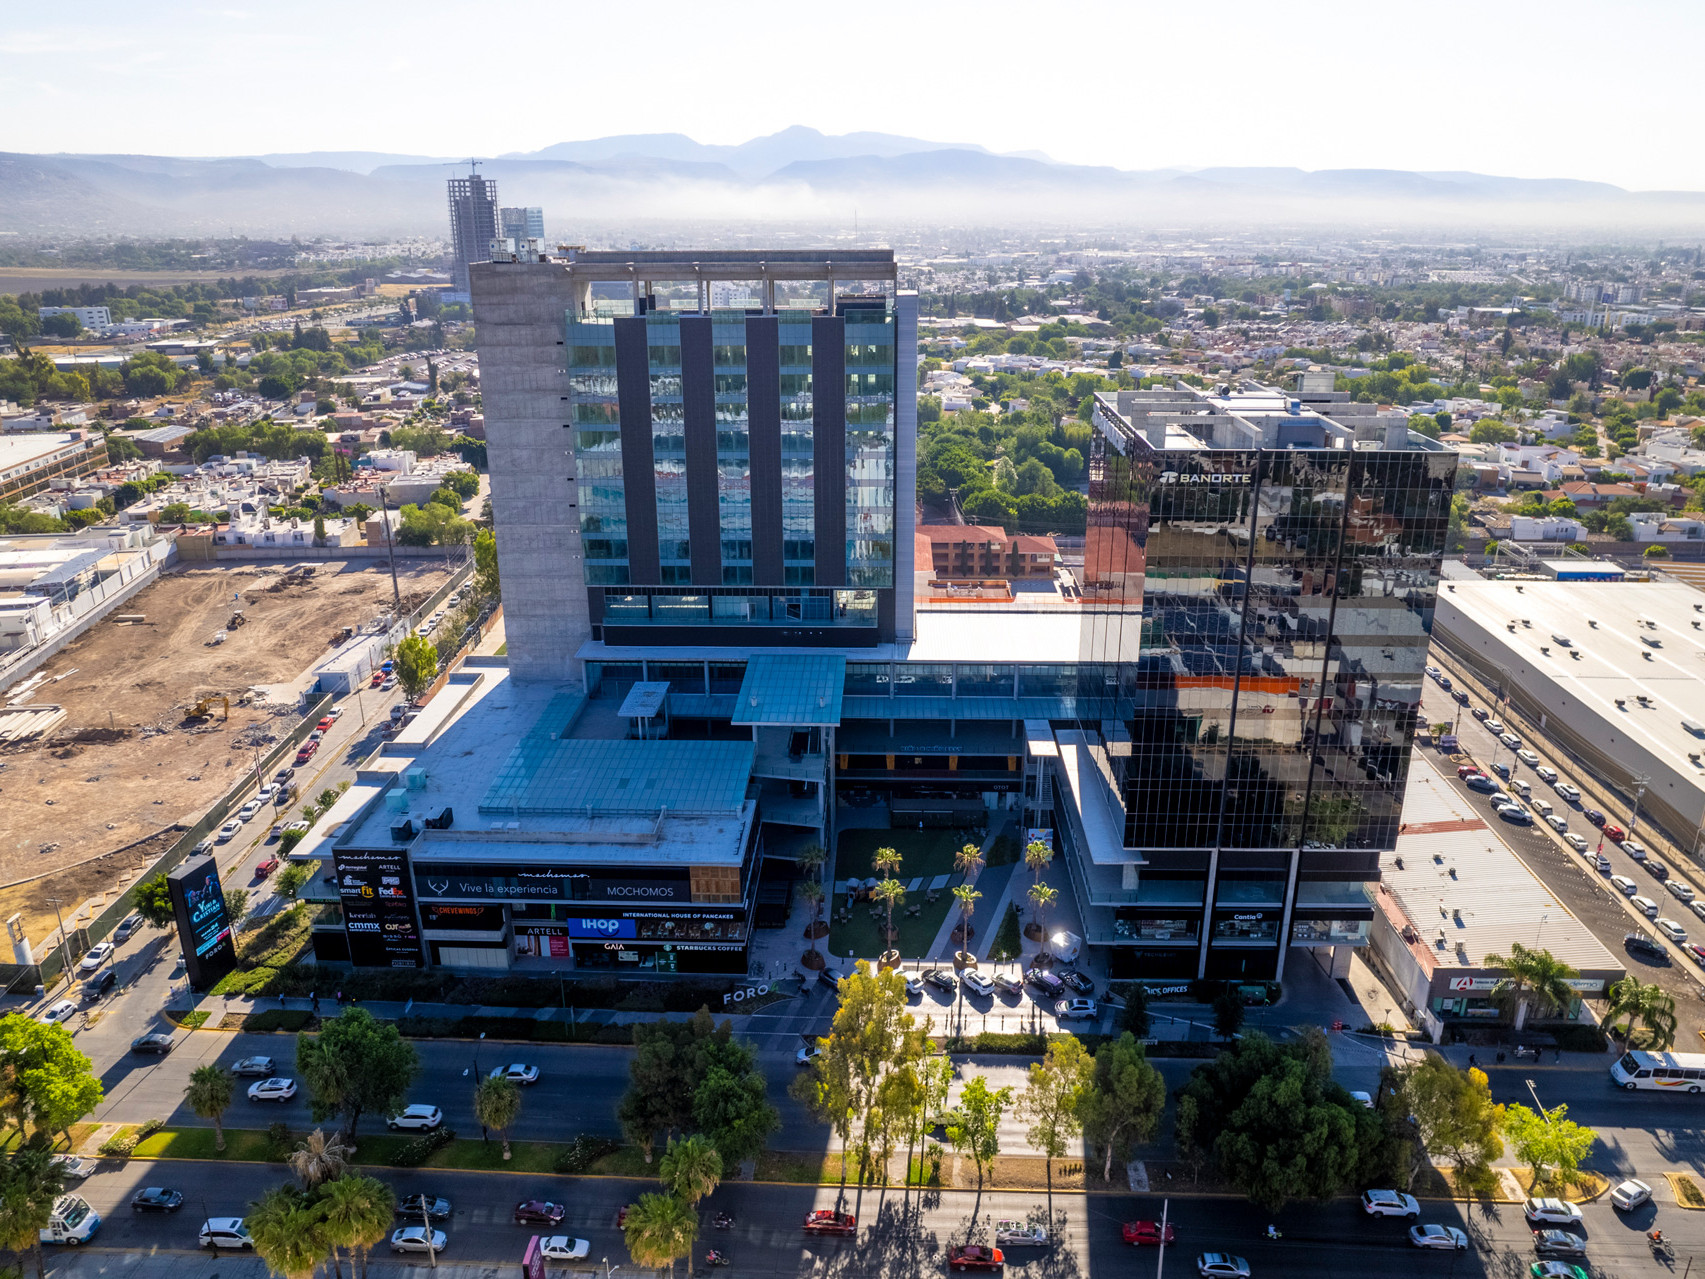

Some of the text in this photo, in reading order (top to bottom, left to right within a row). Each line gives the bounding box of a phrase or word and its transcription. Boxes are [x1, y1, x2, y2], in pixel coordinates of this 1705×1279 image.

[1180, 473, 1252, 483] BANORTE
[361, 885, 374, 895] fit
[378, 887, 403, 895] FedEx
[459, 883, 558, 896] Vive la experiencia
[607, 886, 674, 897] MOCHOMOS
[438, 906, 477, 915] CHEVEWINGS
[348, 921, 380, 929] cmmx
[527, 927, 563, 935] ARTELL
[205, 944, 222, 959] FORO
[723, 984, 769, 1005] FORO
